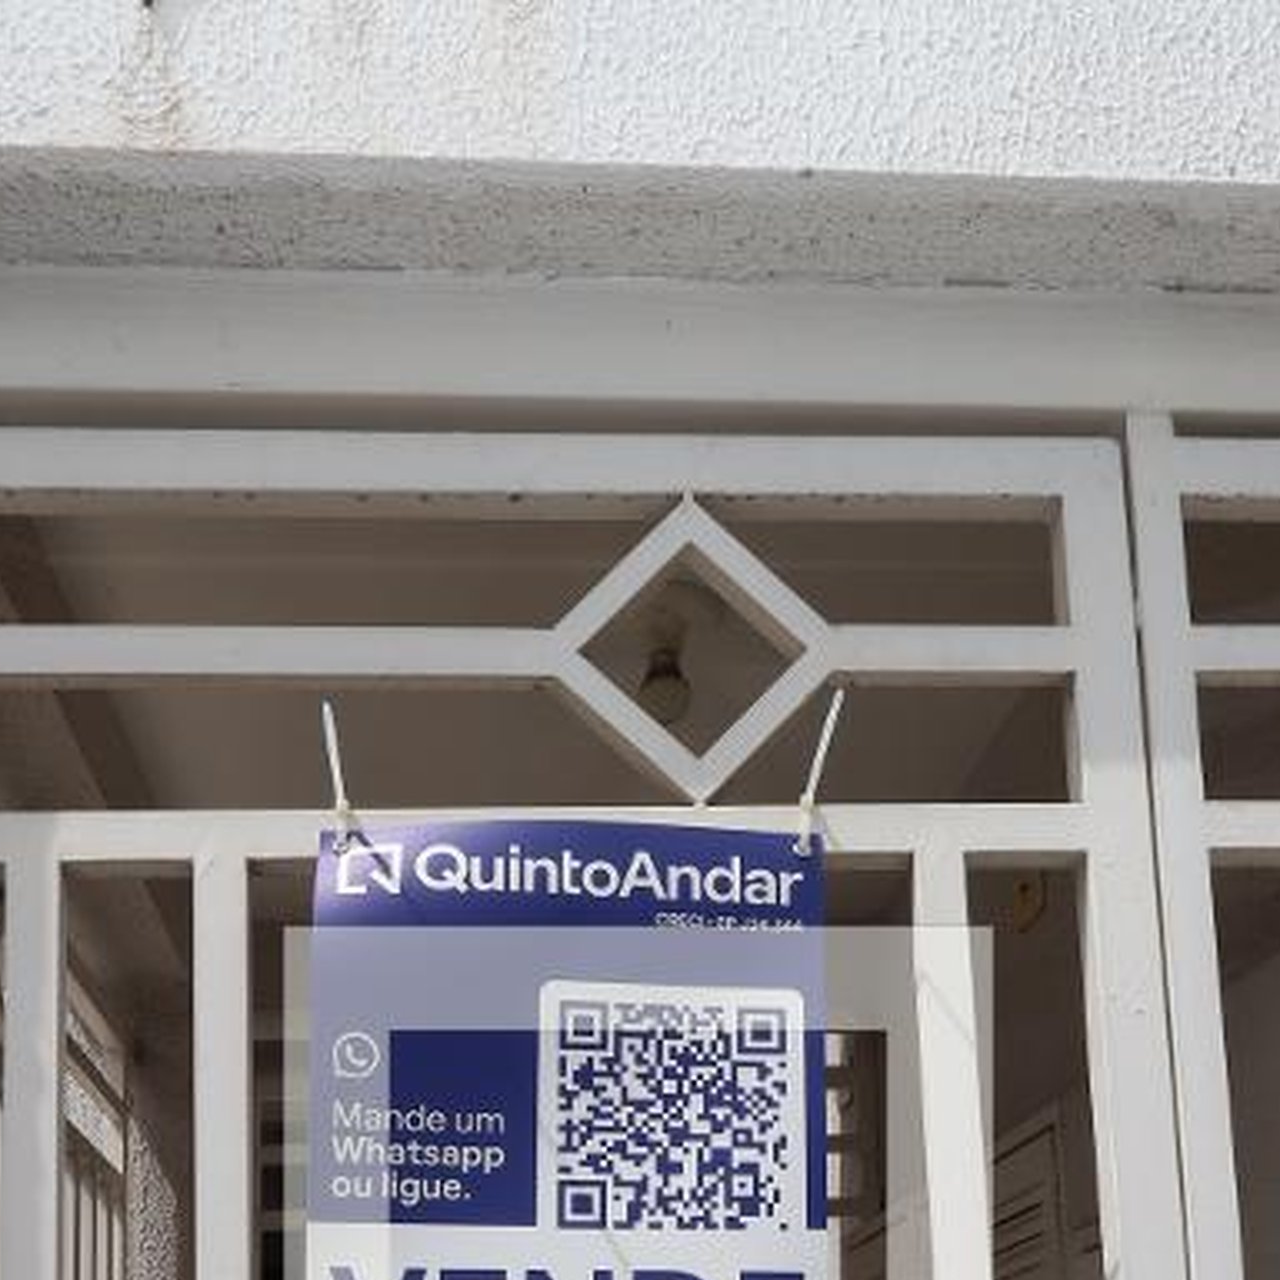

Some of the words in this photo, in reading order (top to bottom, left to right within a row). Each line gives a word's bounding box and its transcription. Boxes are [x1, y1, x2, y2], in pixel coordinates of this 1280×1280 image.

[414, 846, 804, 906] QuintoAndar
[332, 1100, 446, 1132] Mande
[455, 1111, 505, 1132] um
[332, 1136, 506, 1174] Whatsapp
[332, 1175, 371, 1198] ou
[381, 1171, 471, 1206] ligue.
